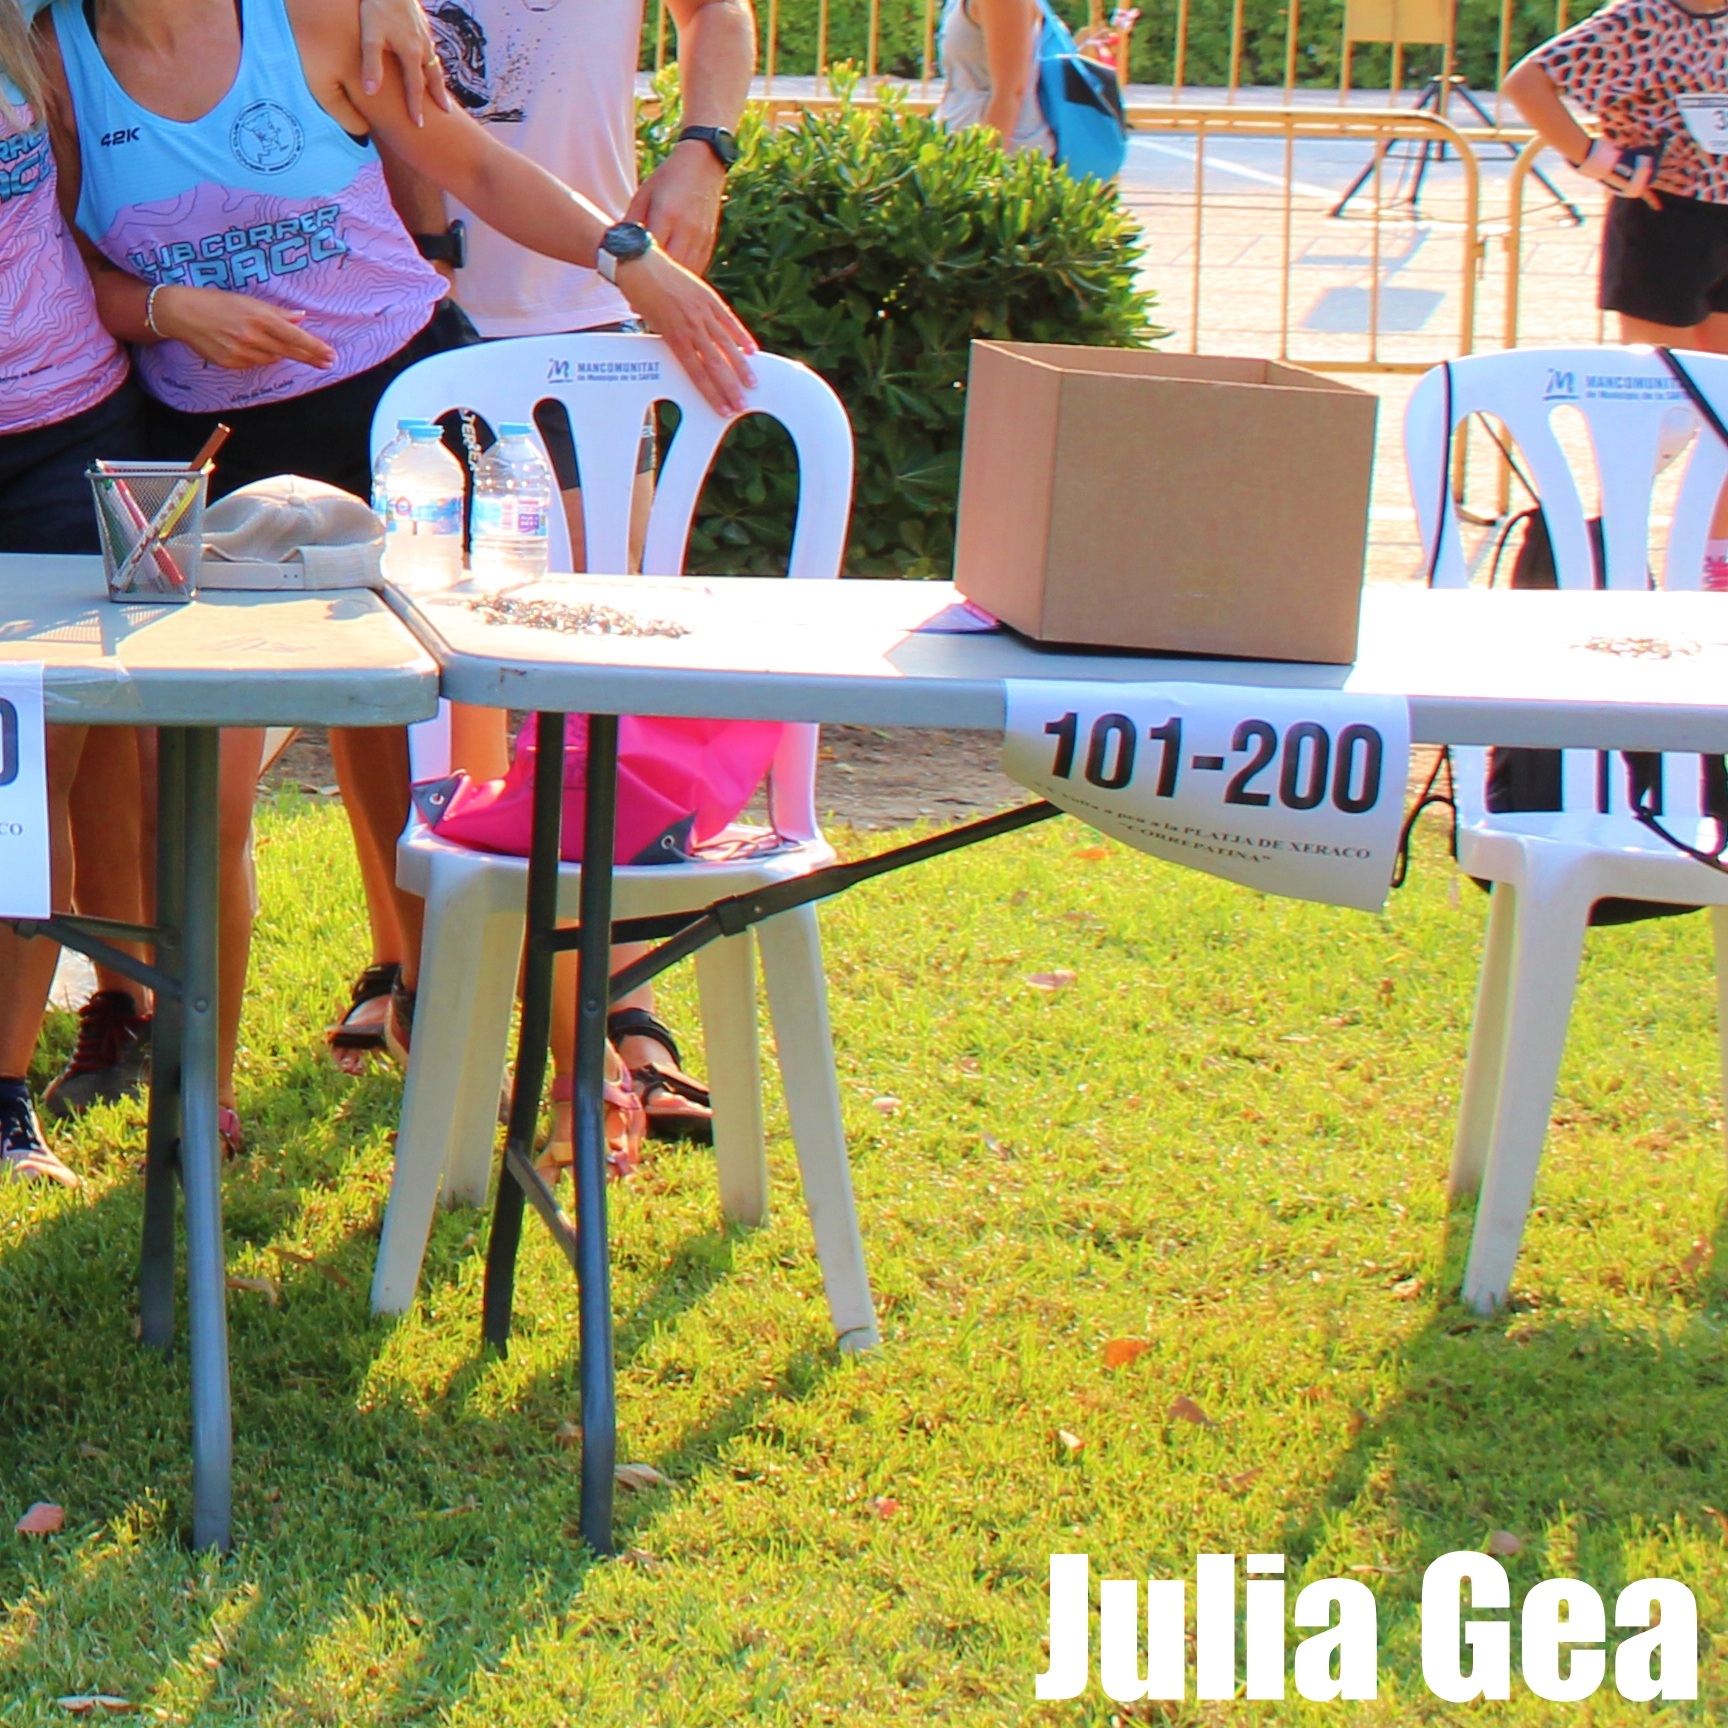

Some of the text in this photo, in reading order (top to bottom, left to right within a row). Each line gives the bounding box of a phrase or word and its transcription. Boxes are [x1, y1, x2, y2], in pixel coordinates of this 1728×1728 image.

[100, 127, 141, 148] 42K
[577, 361, 660, 373] MANCOMUNITAT
[1044, 712, 1383, 815] 101-200
[1184, 825, 1253, 847] PLATJA
[1257, 837, 1283, 851] DE
[1288, 840, 1371, 860] XERACO
